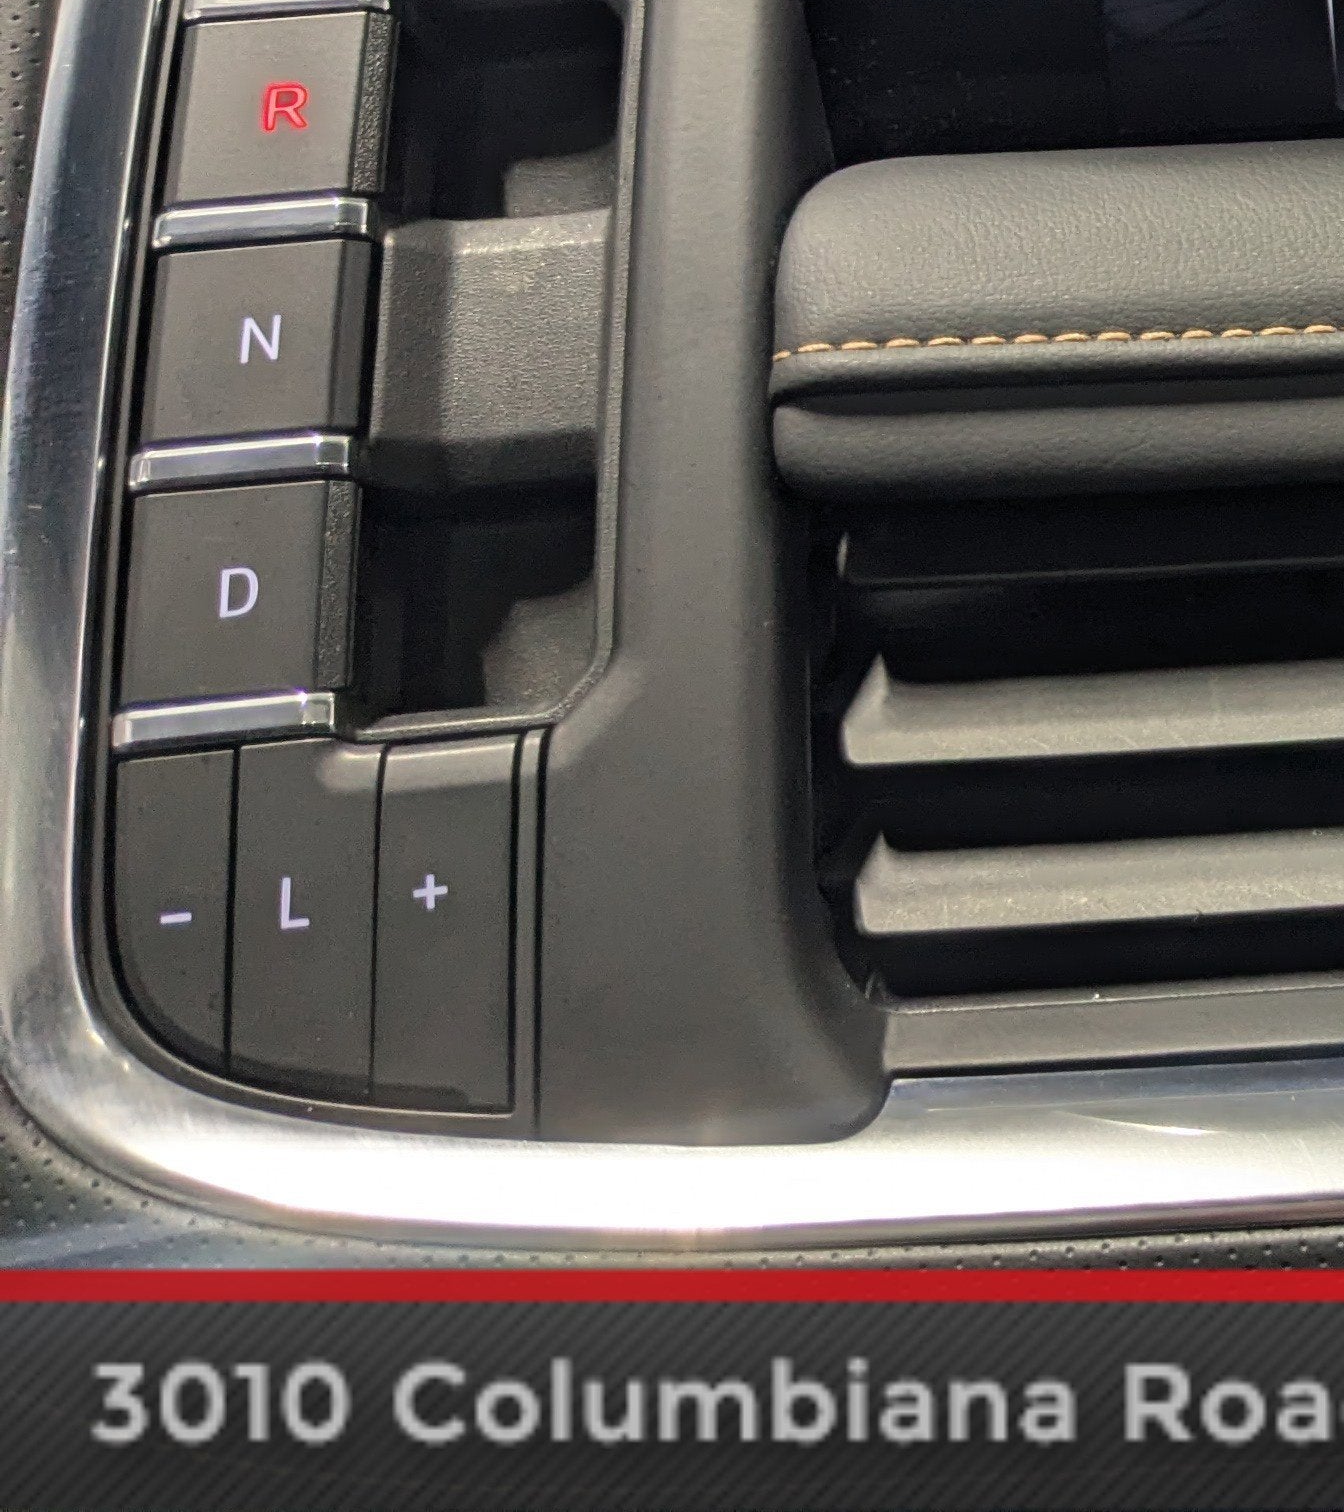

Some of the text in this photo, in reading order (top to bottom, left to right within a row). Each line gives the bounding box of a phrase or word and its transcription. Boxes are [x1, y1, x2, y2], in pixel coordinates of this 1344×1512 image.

[259, 81, 310, 134] R
[239, 314, 283, 364] N
[218, 567, 259, 619] D
[279, 876, 310, 930] L
